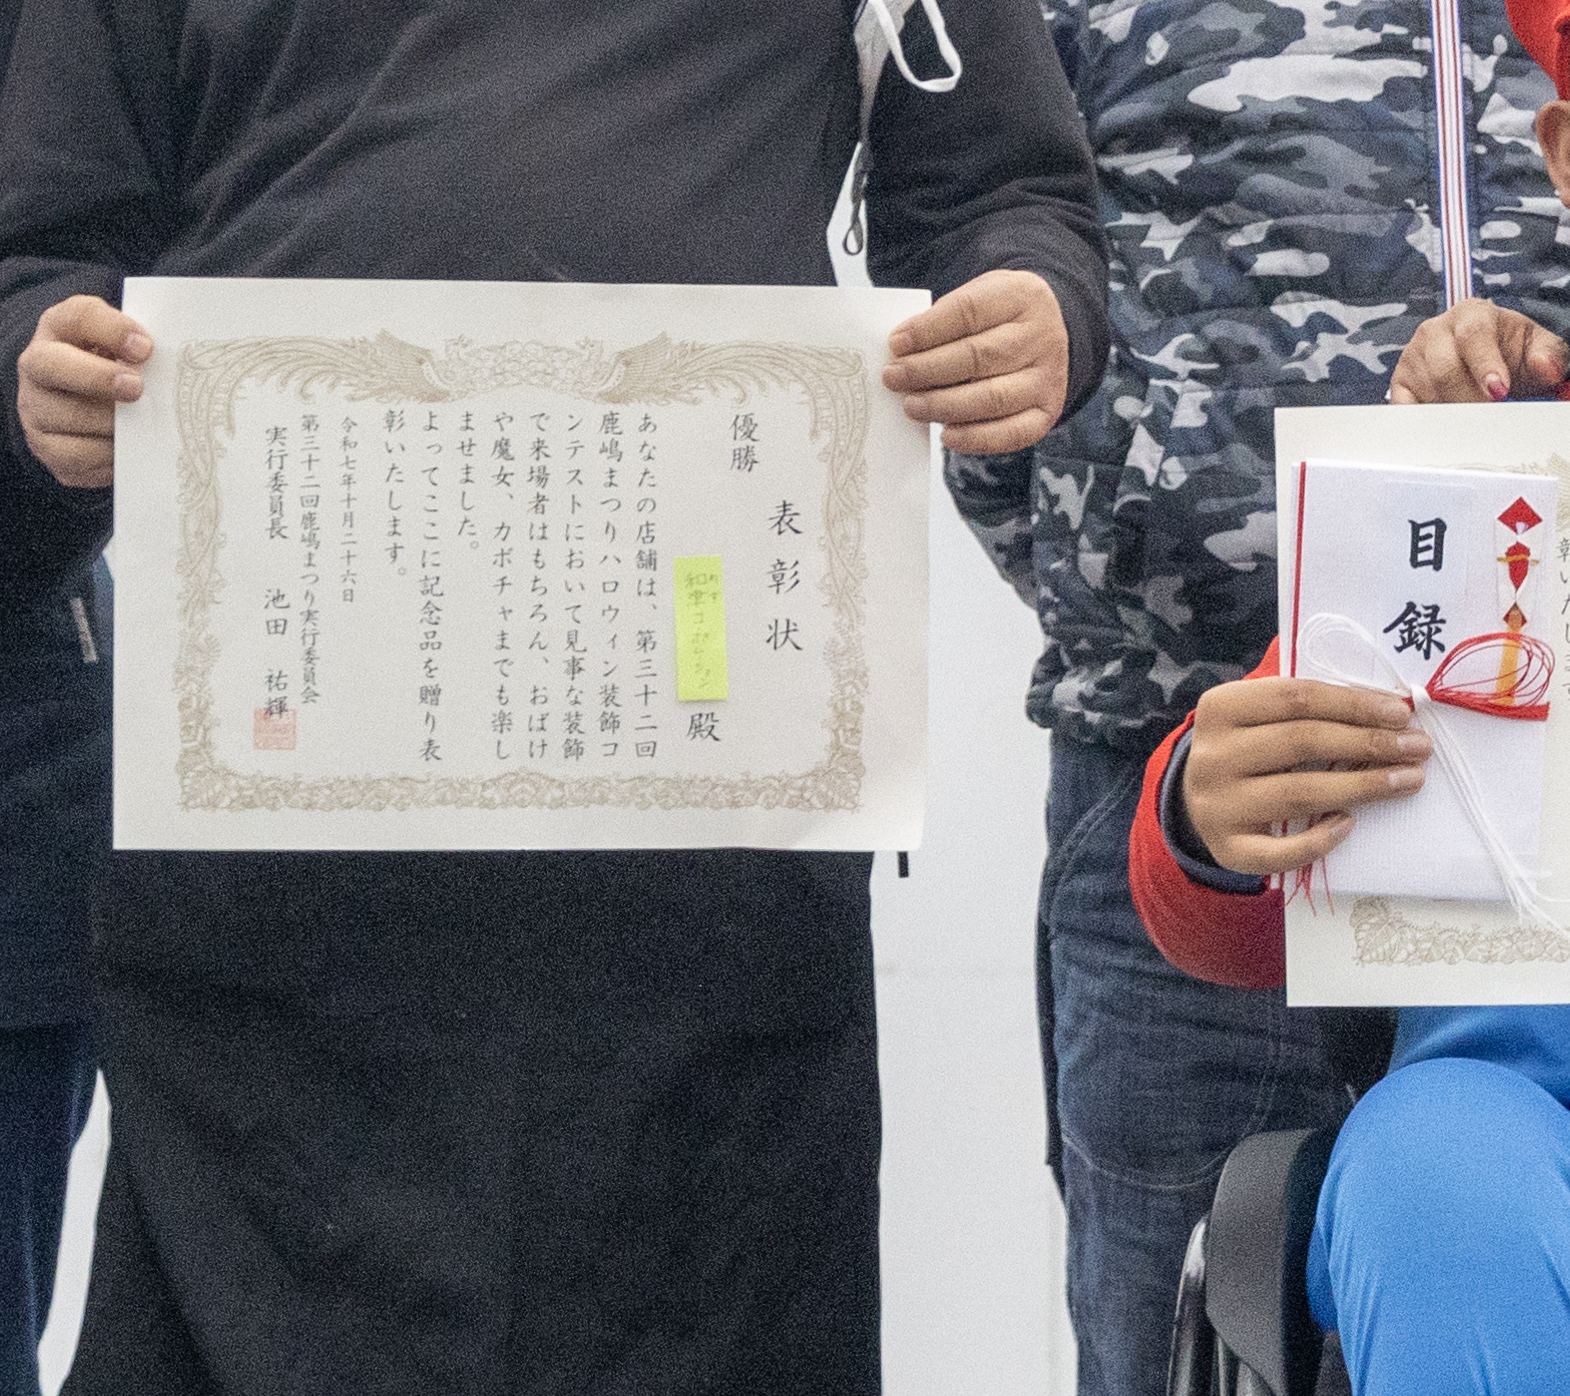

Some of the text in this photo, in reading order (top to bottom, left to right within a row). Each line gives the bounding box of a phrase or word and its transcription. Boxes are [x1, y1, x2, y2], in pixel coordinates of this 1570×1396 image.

[730, 412, 760, 474] 優勝
[764, 499, 804, 652] 表彰状
[1382, 517, 1448, 661] 目録
[686, 711, 722, 743] 殿
